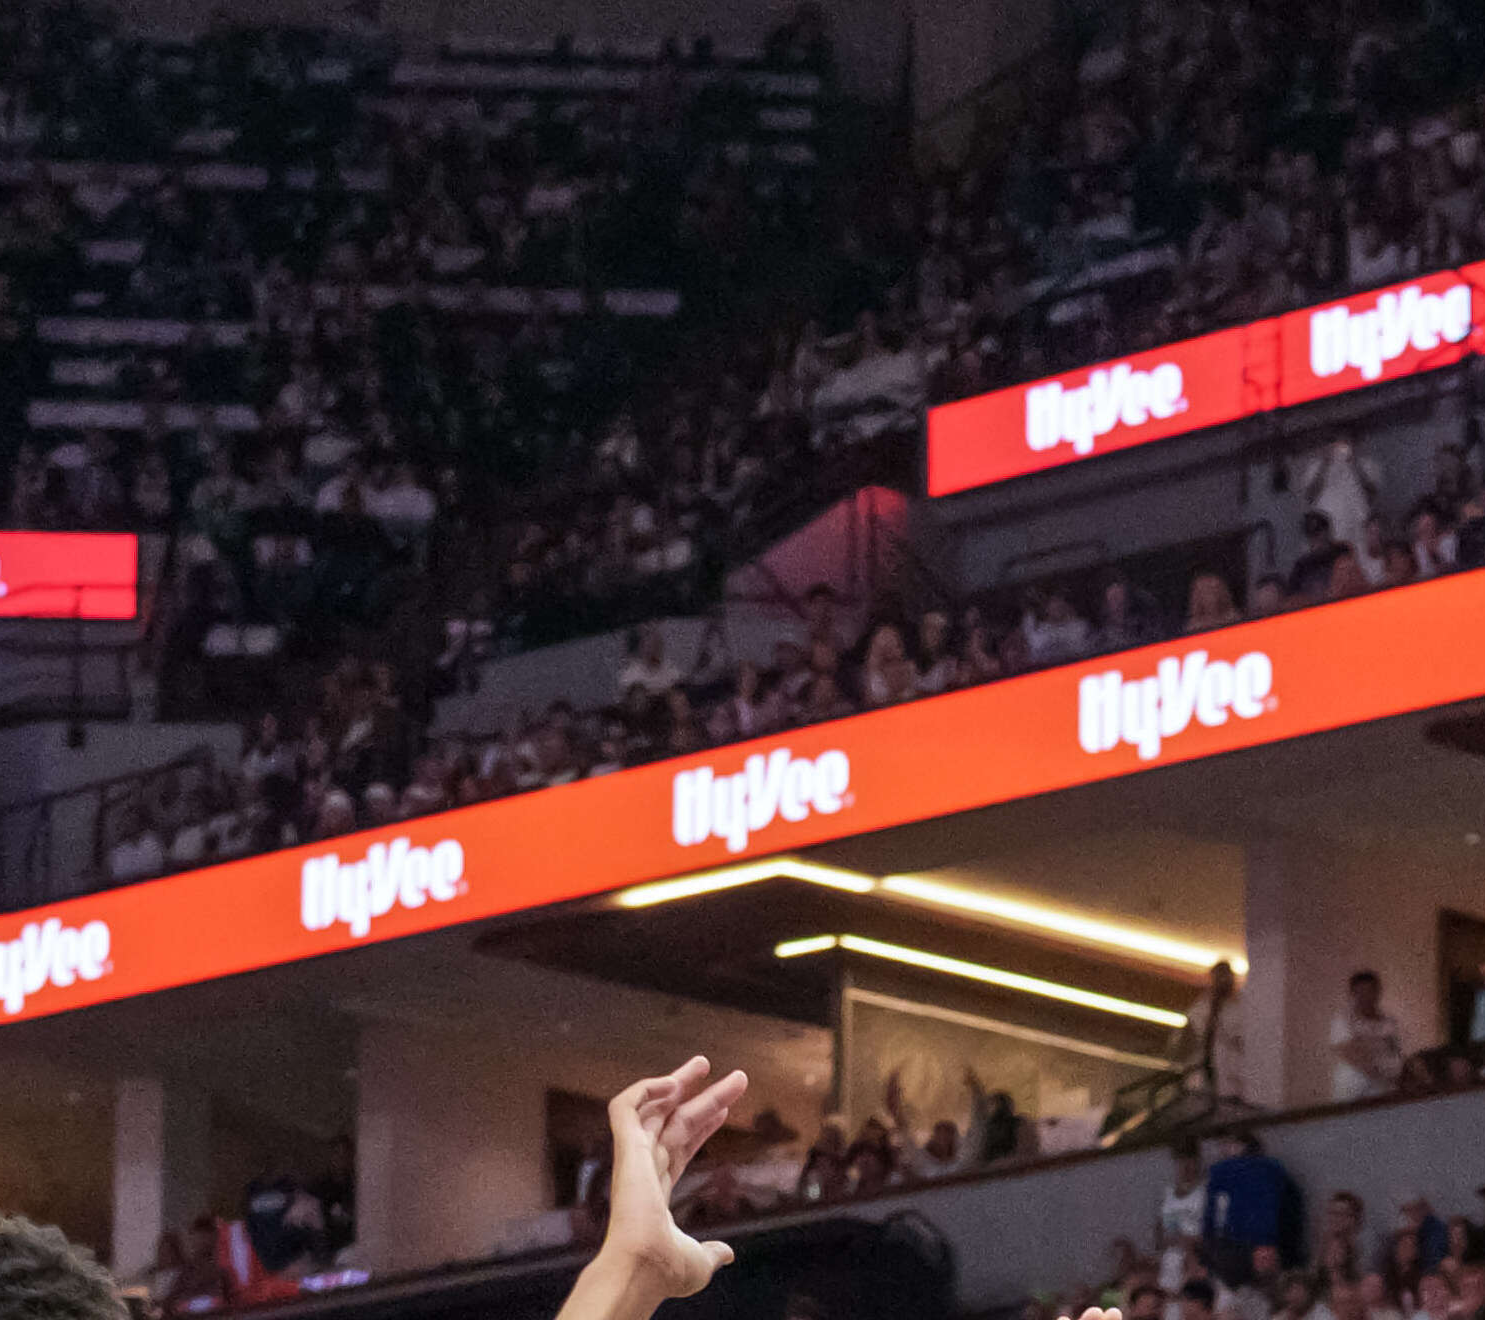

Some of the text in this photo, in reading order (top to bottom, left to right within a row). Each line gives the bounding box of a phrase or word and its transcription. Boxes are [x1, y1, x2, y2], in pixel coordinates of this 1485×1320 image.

[1026, 363, 1184, 454] HyVee
[1078, 650, 1273, 761] HyVee
[672, 748, 850, 853] HyVee
[301, 837, 464, 938] HyVee
